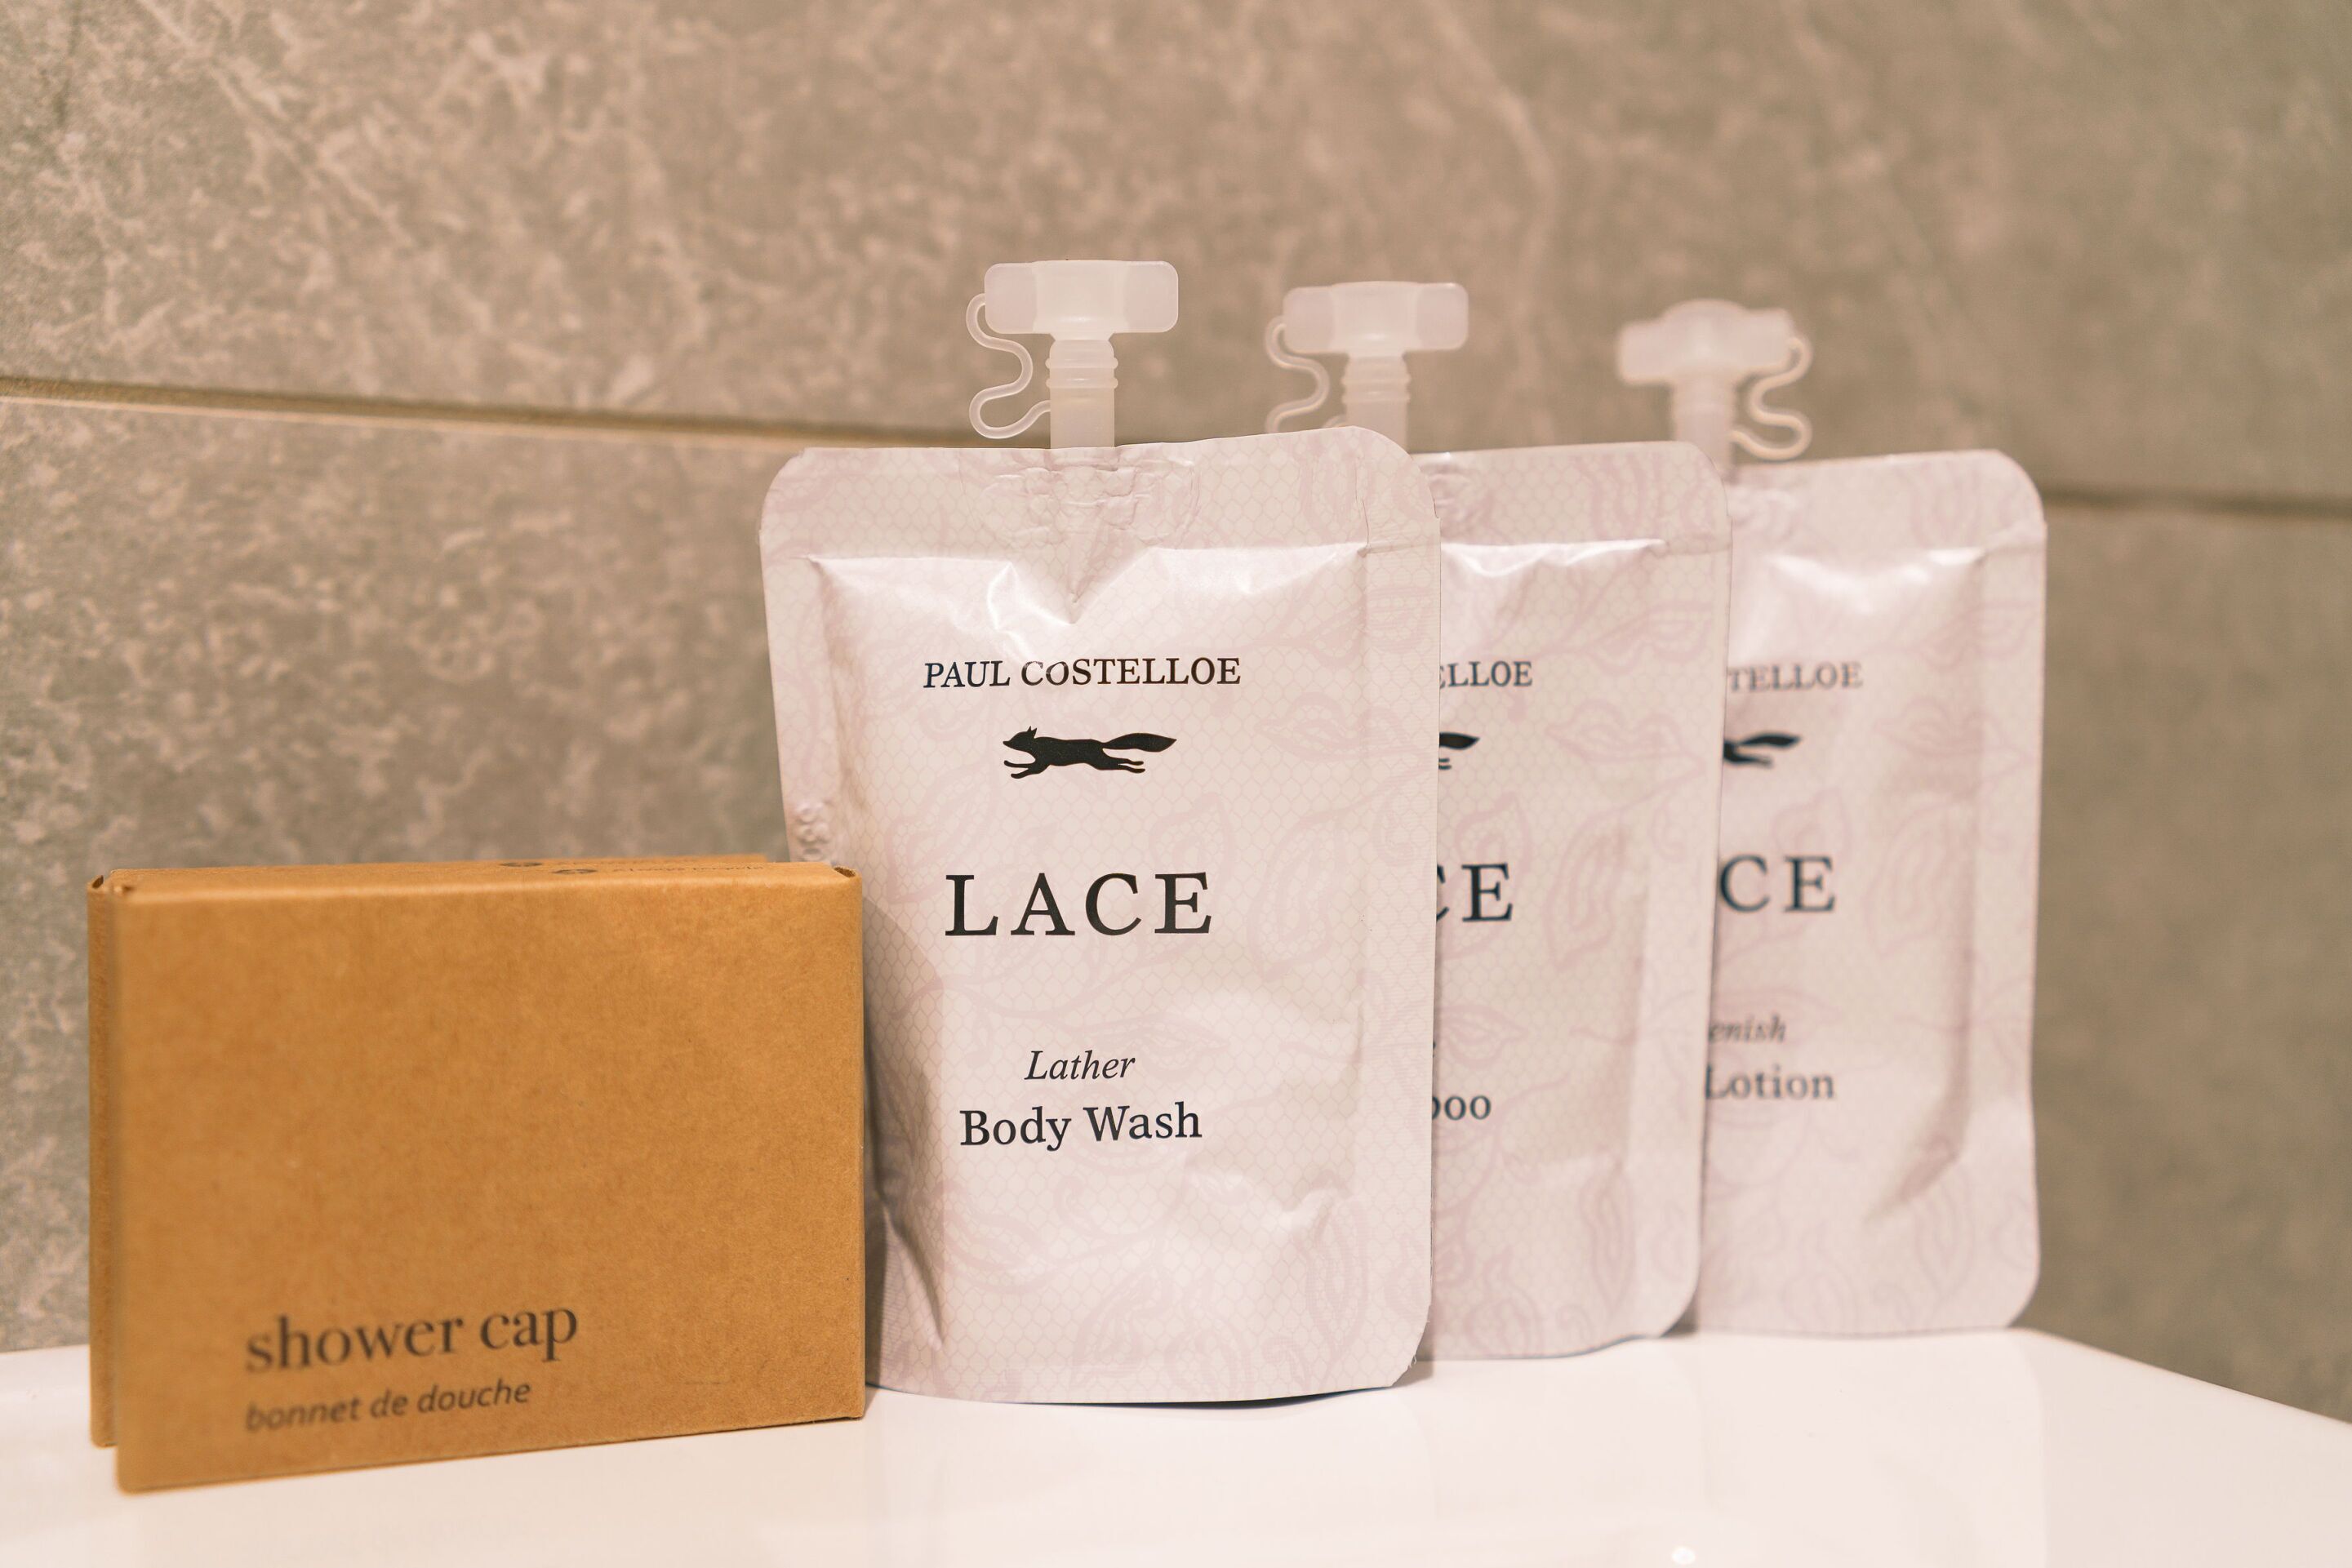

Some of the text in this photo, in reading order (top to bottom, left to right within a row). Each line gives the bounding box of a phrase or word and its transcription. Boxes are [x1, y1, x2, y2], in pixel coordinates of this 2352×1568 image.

[923, 657, 1241, 689] PAUL COSTELLOE
[1439, 660, 1533, 690] LLOE
[945, 872, 1212, 937] LACE
[1718, 854, 1836, 913] CE
[1024, 1050, 1136, 1081] Lather
[1705, 1063, 1834, 1099] Lotion
[959, 1100, 1203, 1152] Body Wash
[246, 1308, 579, 1374] shower cap
[246, 1377, 531, 1433] bonnet de douche
